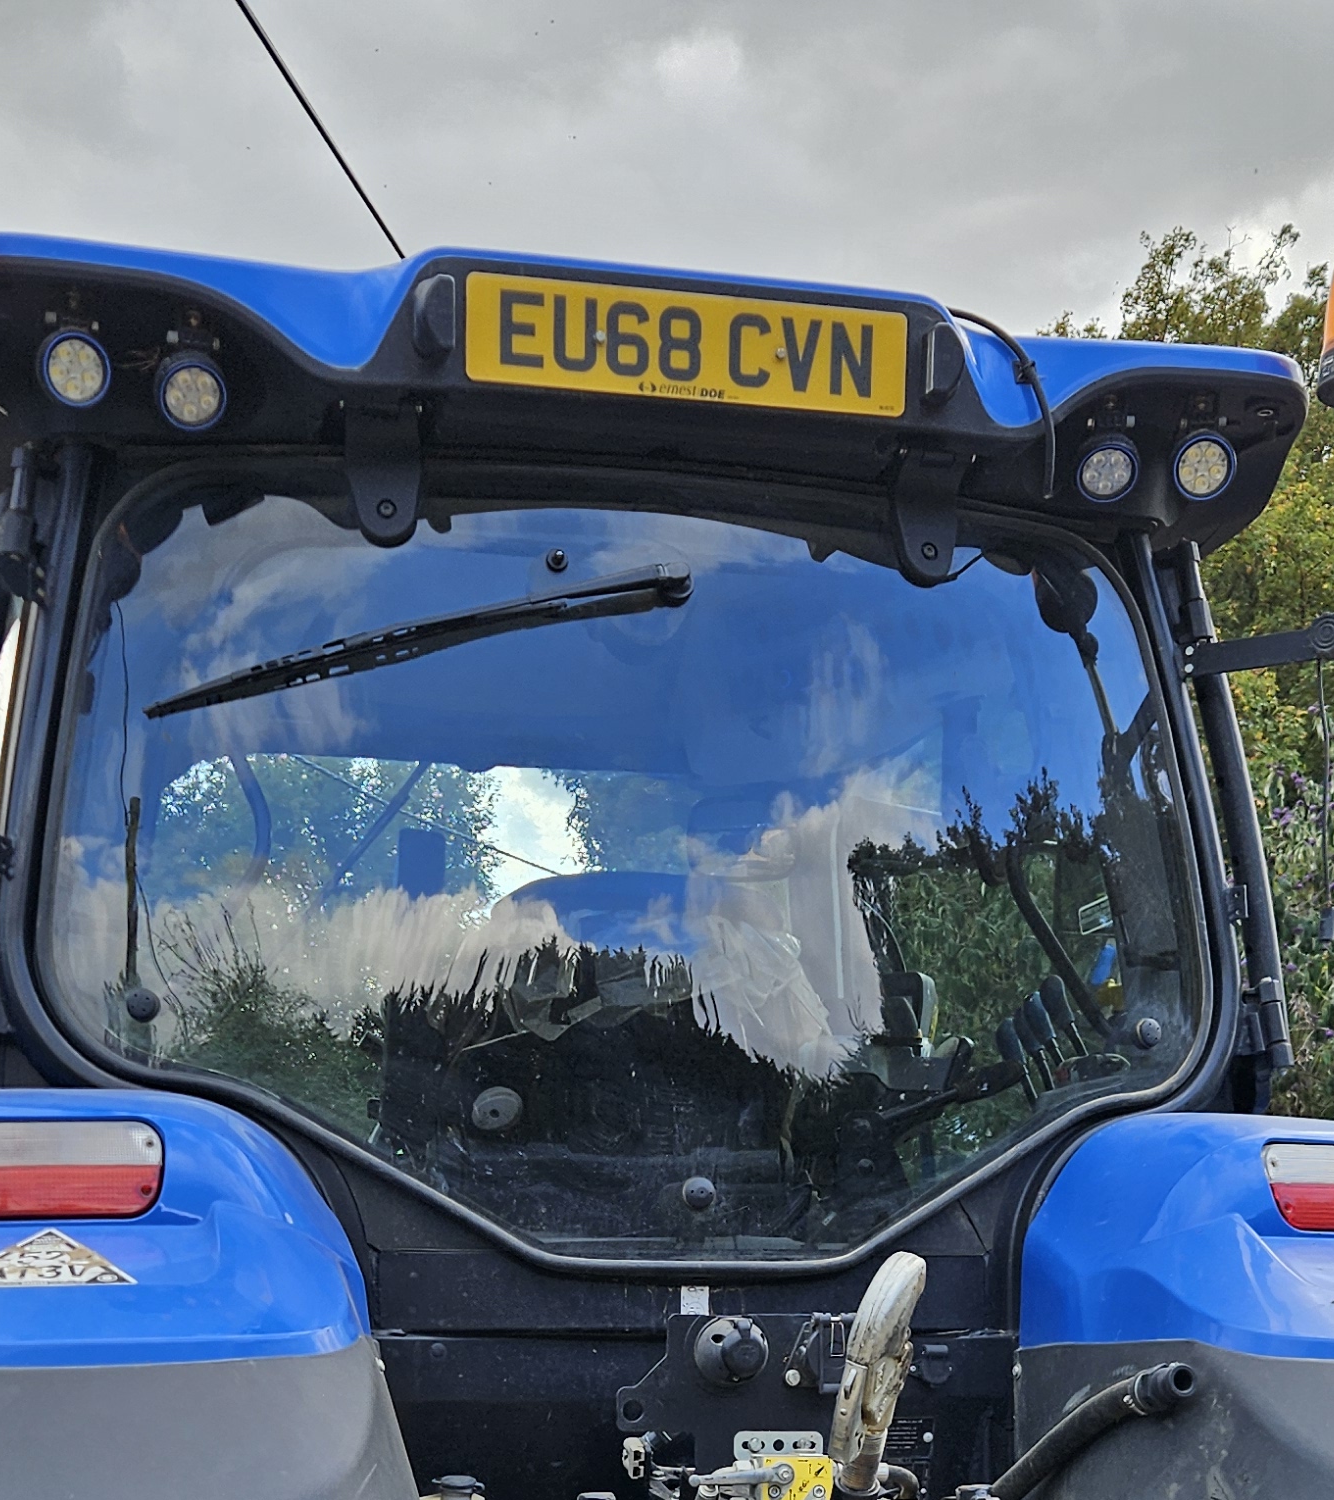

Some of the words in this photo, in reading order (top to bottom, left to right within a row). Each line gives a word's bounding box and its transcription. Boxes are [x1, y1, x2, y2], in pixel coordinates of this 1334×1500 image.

[499, 288, 702, 382] EU68
[729, 312, 874, 399] CVN
[659, 383, 697, 397] ernest
[700, 387, 726, 400] DOE
